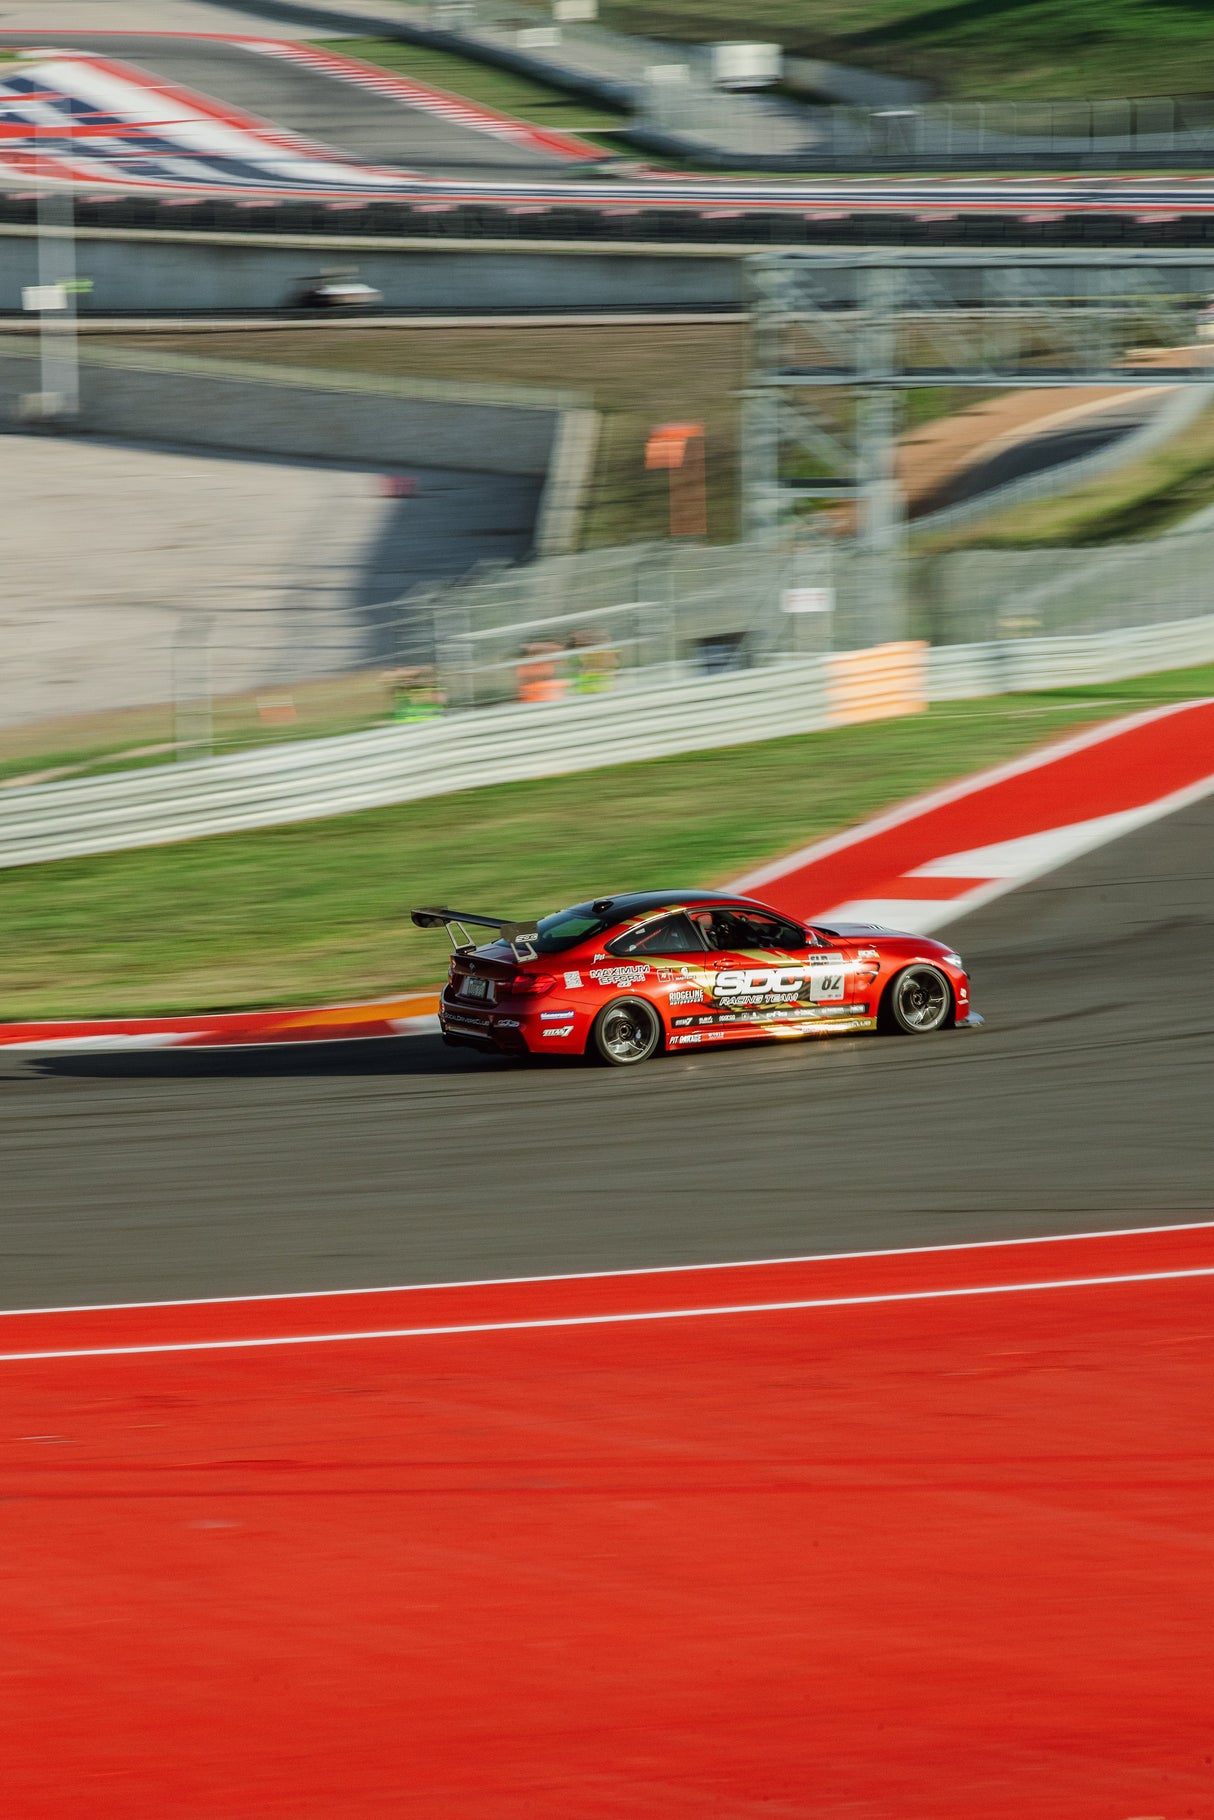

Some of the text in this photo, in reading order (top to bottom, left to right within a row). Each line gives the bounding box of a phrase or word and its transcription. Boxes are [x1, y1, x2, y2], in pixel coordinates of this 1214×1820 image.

[590, 965, 651, 978] MAXIMUM
[713, 967, 804, 997] SDC
[669, 989, 704, 1001] RIDGELINE
[719, 995, 763, 1006] RACING
[765, 992, 799, 1003] TEAM
[669, 1036, 679, 1044] PIT
